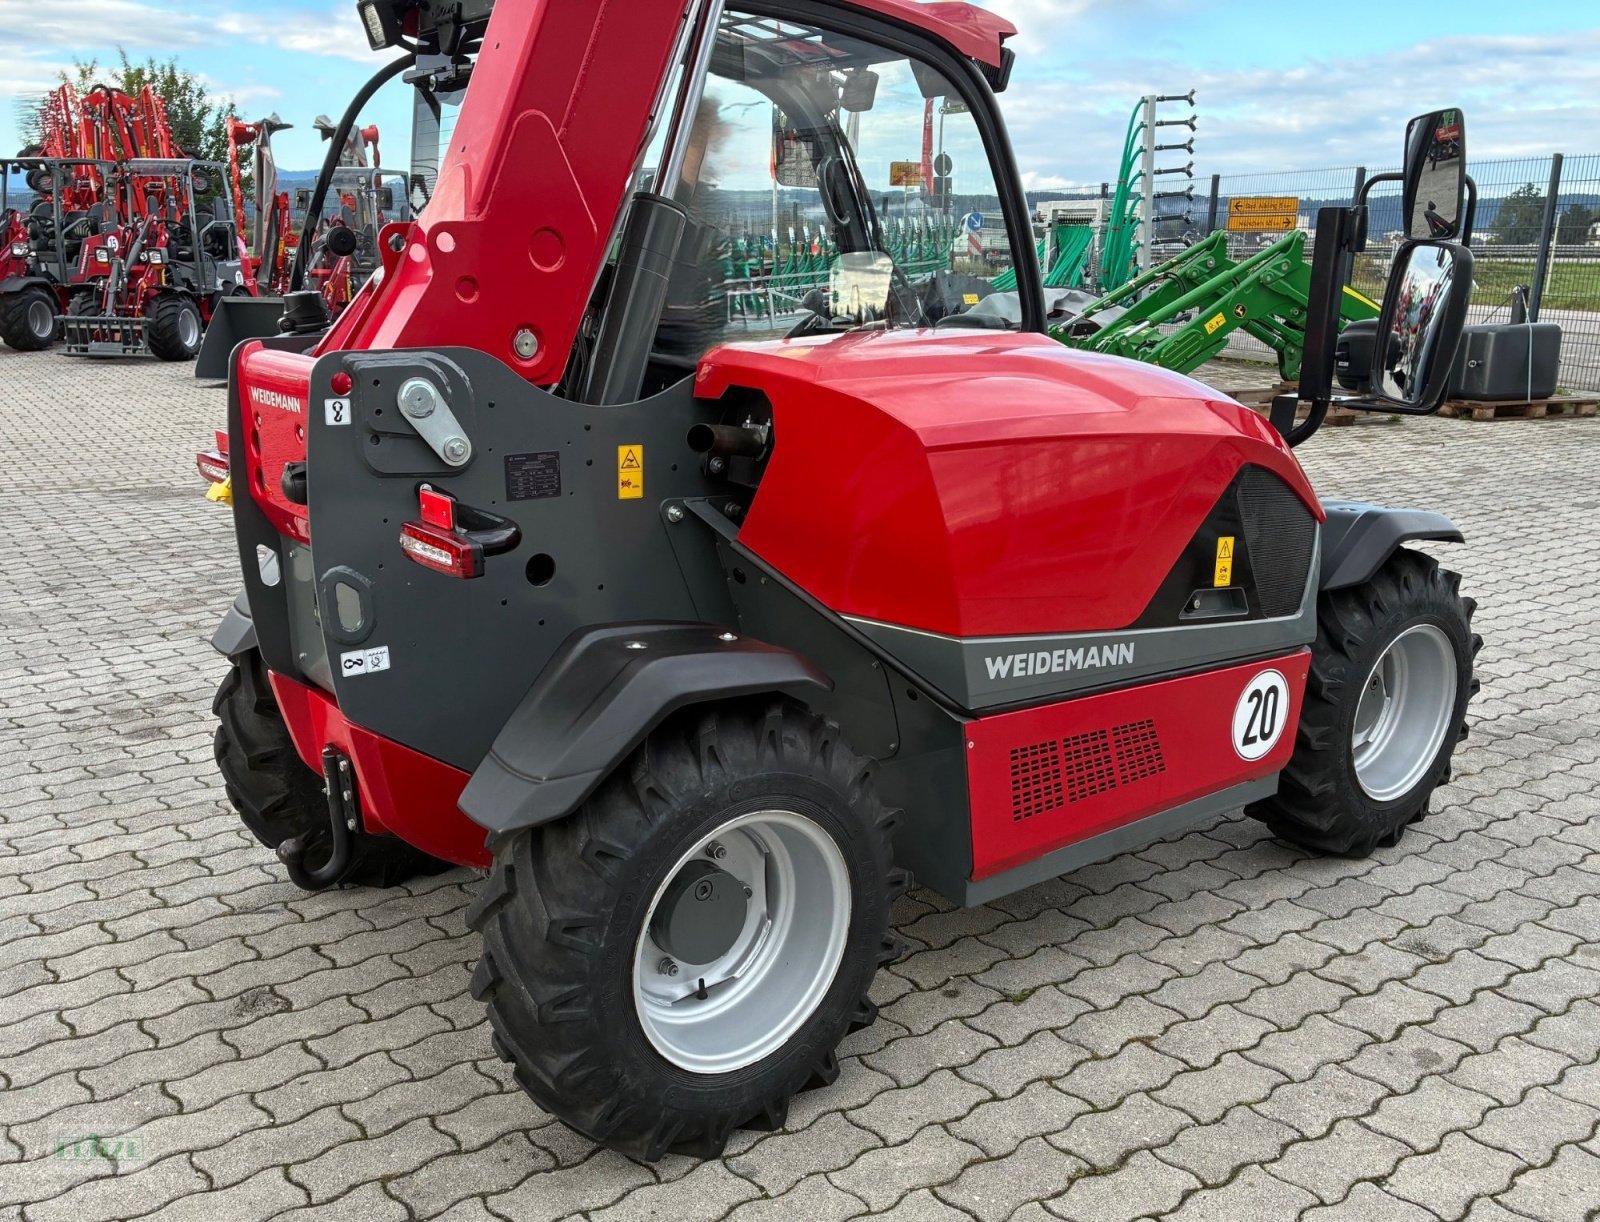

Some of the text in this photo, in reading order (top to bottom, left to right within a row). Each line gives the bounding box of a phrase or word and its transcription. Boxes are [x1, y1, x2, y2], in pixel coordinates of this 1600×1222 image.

[250, 386, 301, 414] WEIDEMANN
[985, 643, 1135, 680] WEIDEMANN
[1242, 684, 1279, 747] 20
